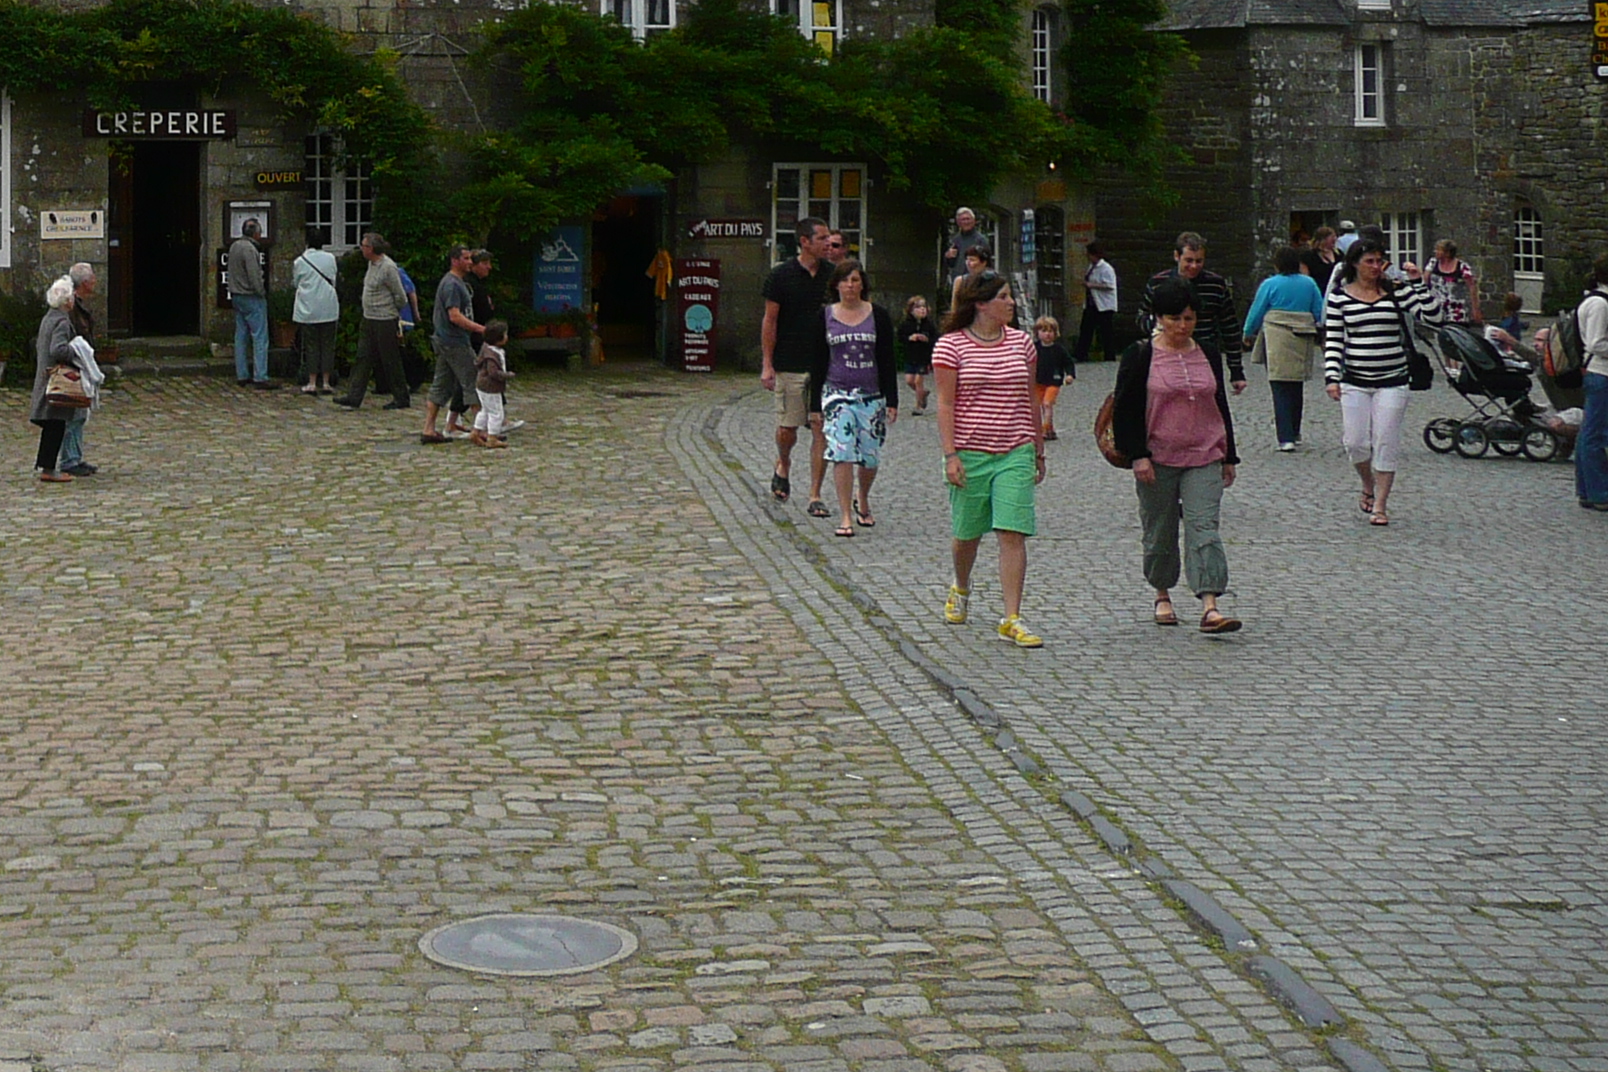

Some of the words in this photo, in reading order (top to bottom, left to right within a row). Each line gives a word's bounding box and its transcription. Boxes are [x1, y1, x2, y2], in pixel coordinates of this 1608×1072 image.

[97, 112, 226, 134] CREPERIE
[257, 172, 301, 183] OUVERT
[704, 223, 723, 236] ART
[724, 223, 738, 236] DU
[740, 222, 763, 236] PAYS
